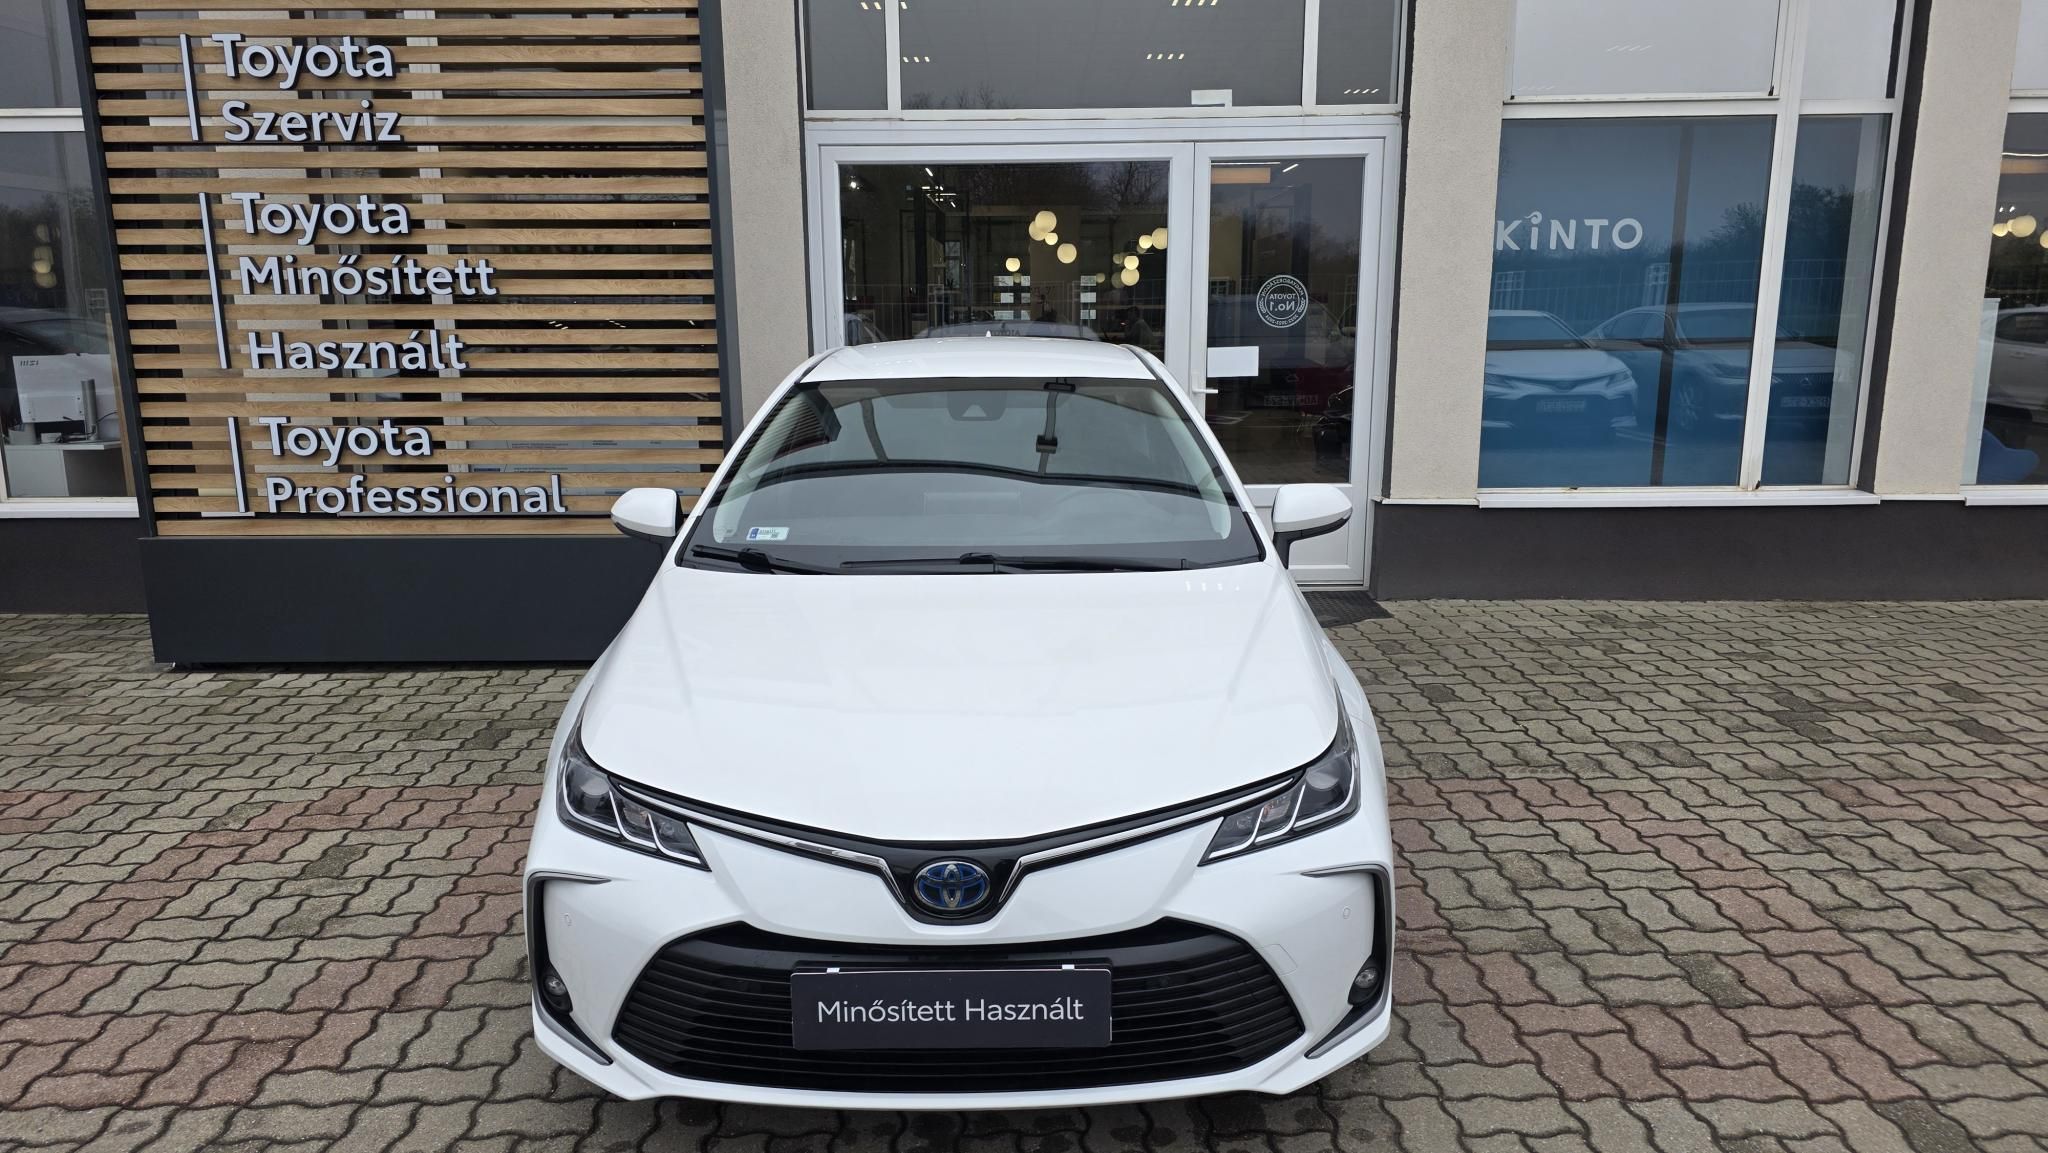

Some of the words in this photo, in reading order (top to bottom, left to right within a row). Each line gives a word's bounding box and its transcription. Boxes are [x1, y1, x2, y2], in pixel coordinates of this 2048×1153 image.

[212, 34, 394, 89] Toyota
[222, 100, 403, 142] Szerviz
[231, 192, 409, 245] Toyota
[239, 255, 498, 295] Minősített
[248, 329, 467, 370] Használt
[258, 416, 432, 467] Toyota
[265, 474, 566, 514] Professional
[817, 999, 956, 1024] Minősített
[965, 996, 1084, 1021] Használt
